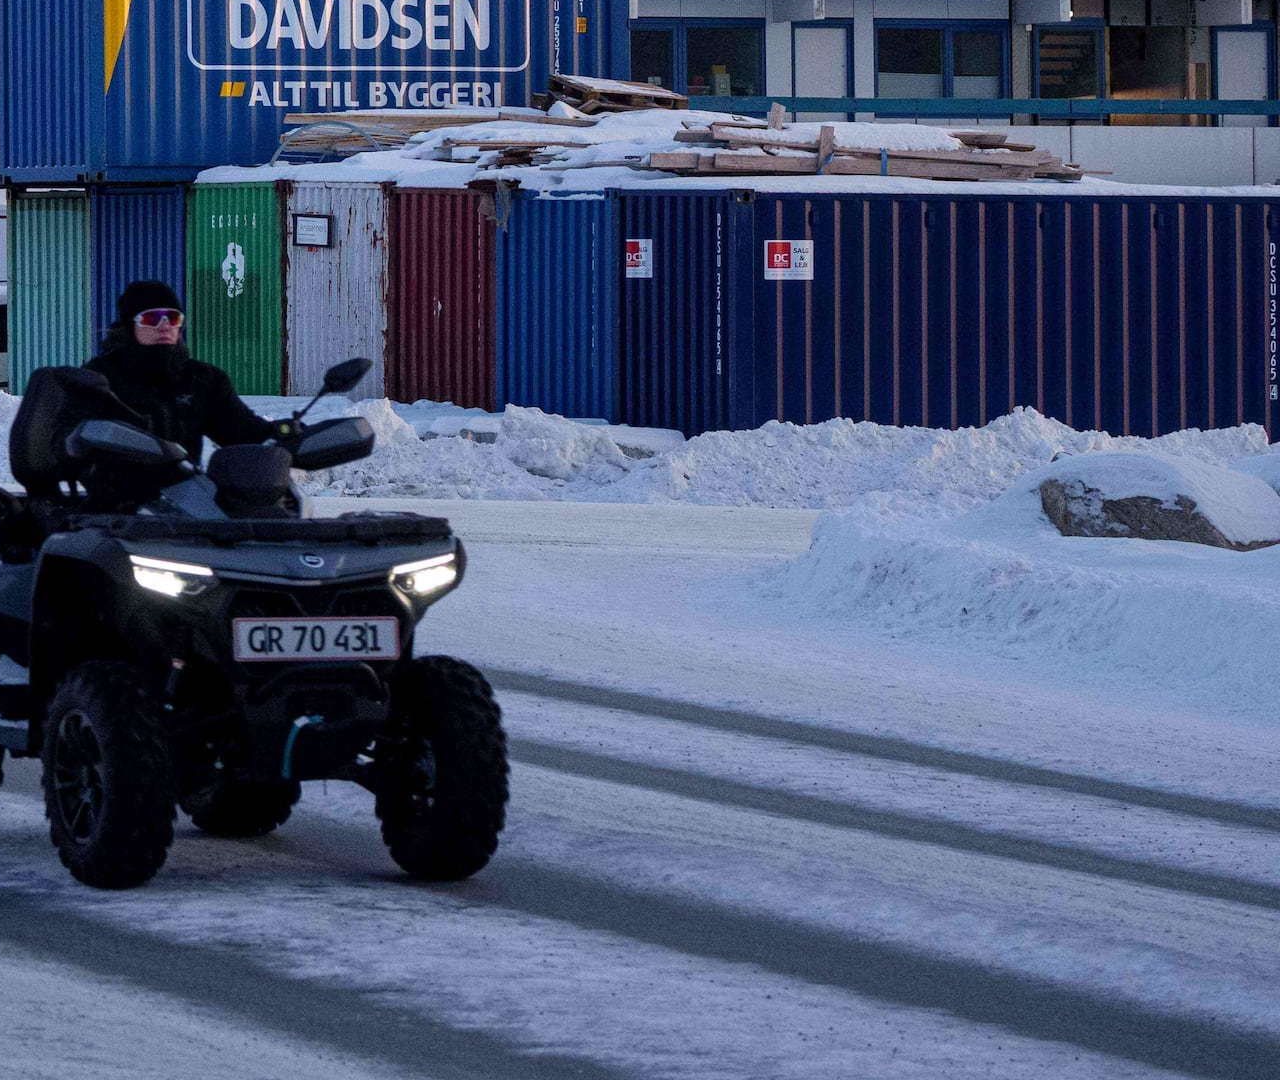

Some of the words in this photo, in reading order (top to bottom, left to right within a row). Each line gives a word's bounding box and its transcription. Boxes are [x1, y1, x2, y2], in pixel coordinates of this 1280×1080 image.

[248, 82, 306, 107] ALT
[311, 82, 360, 107] TIL
[369, 82, 502, 108] BYGGERI
[773, 254, 789, 263] DC
[1269, 243, 1277, 296] DCSU
[1269, 299, 1277, 380] 354065
[248, 626, 285, 653] GR
[292, 625, 326, 652] 70
[334, 623, 382, 652] 431
